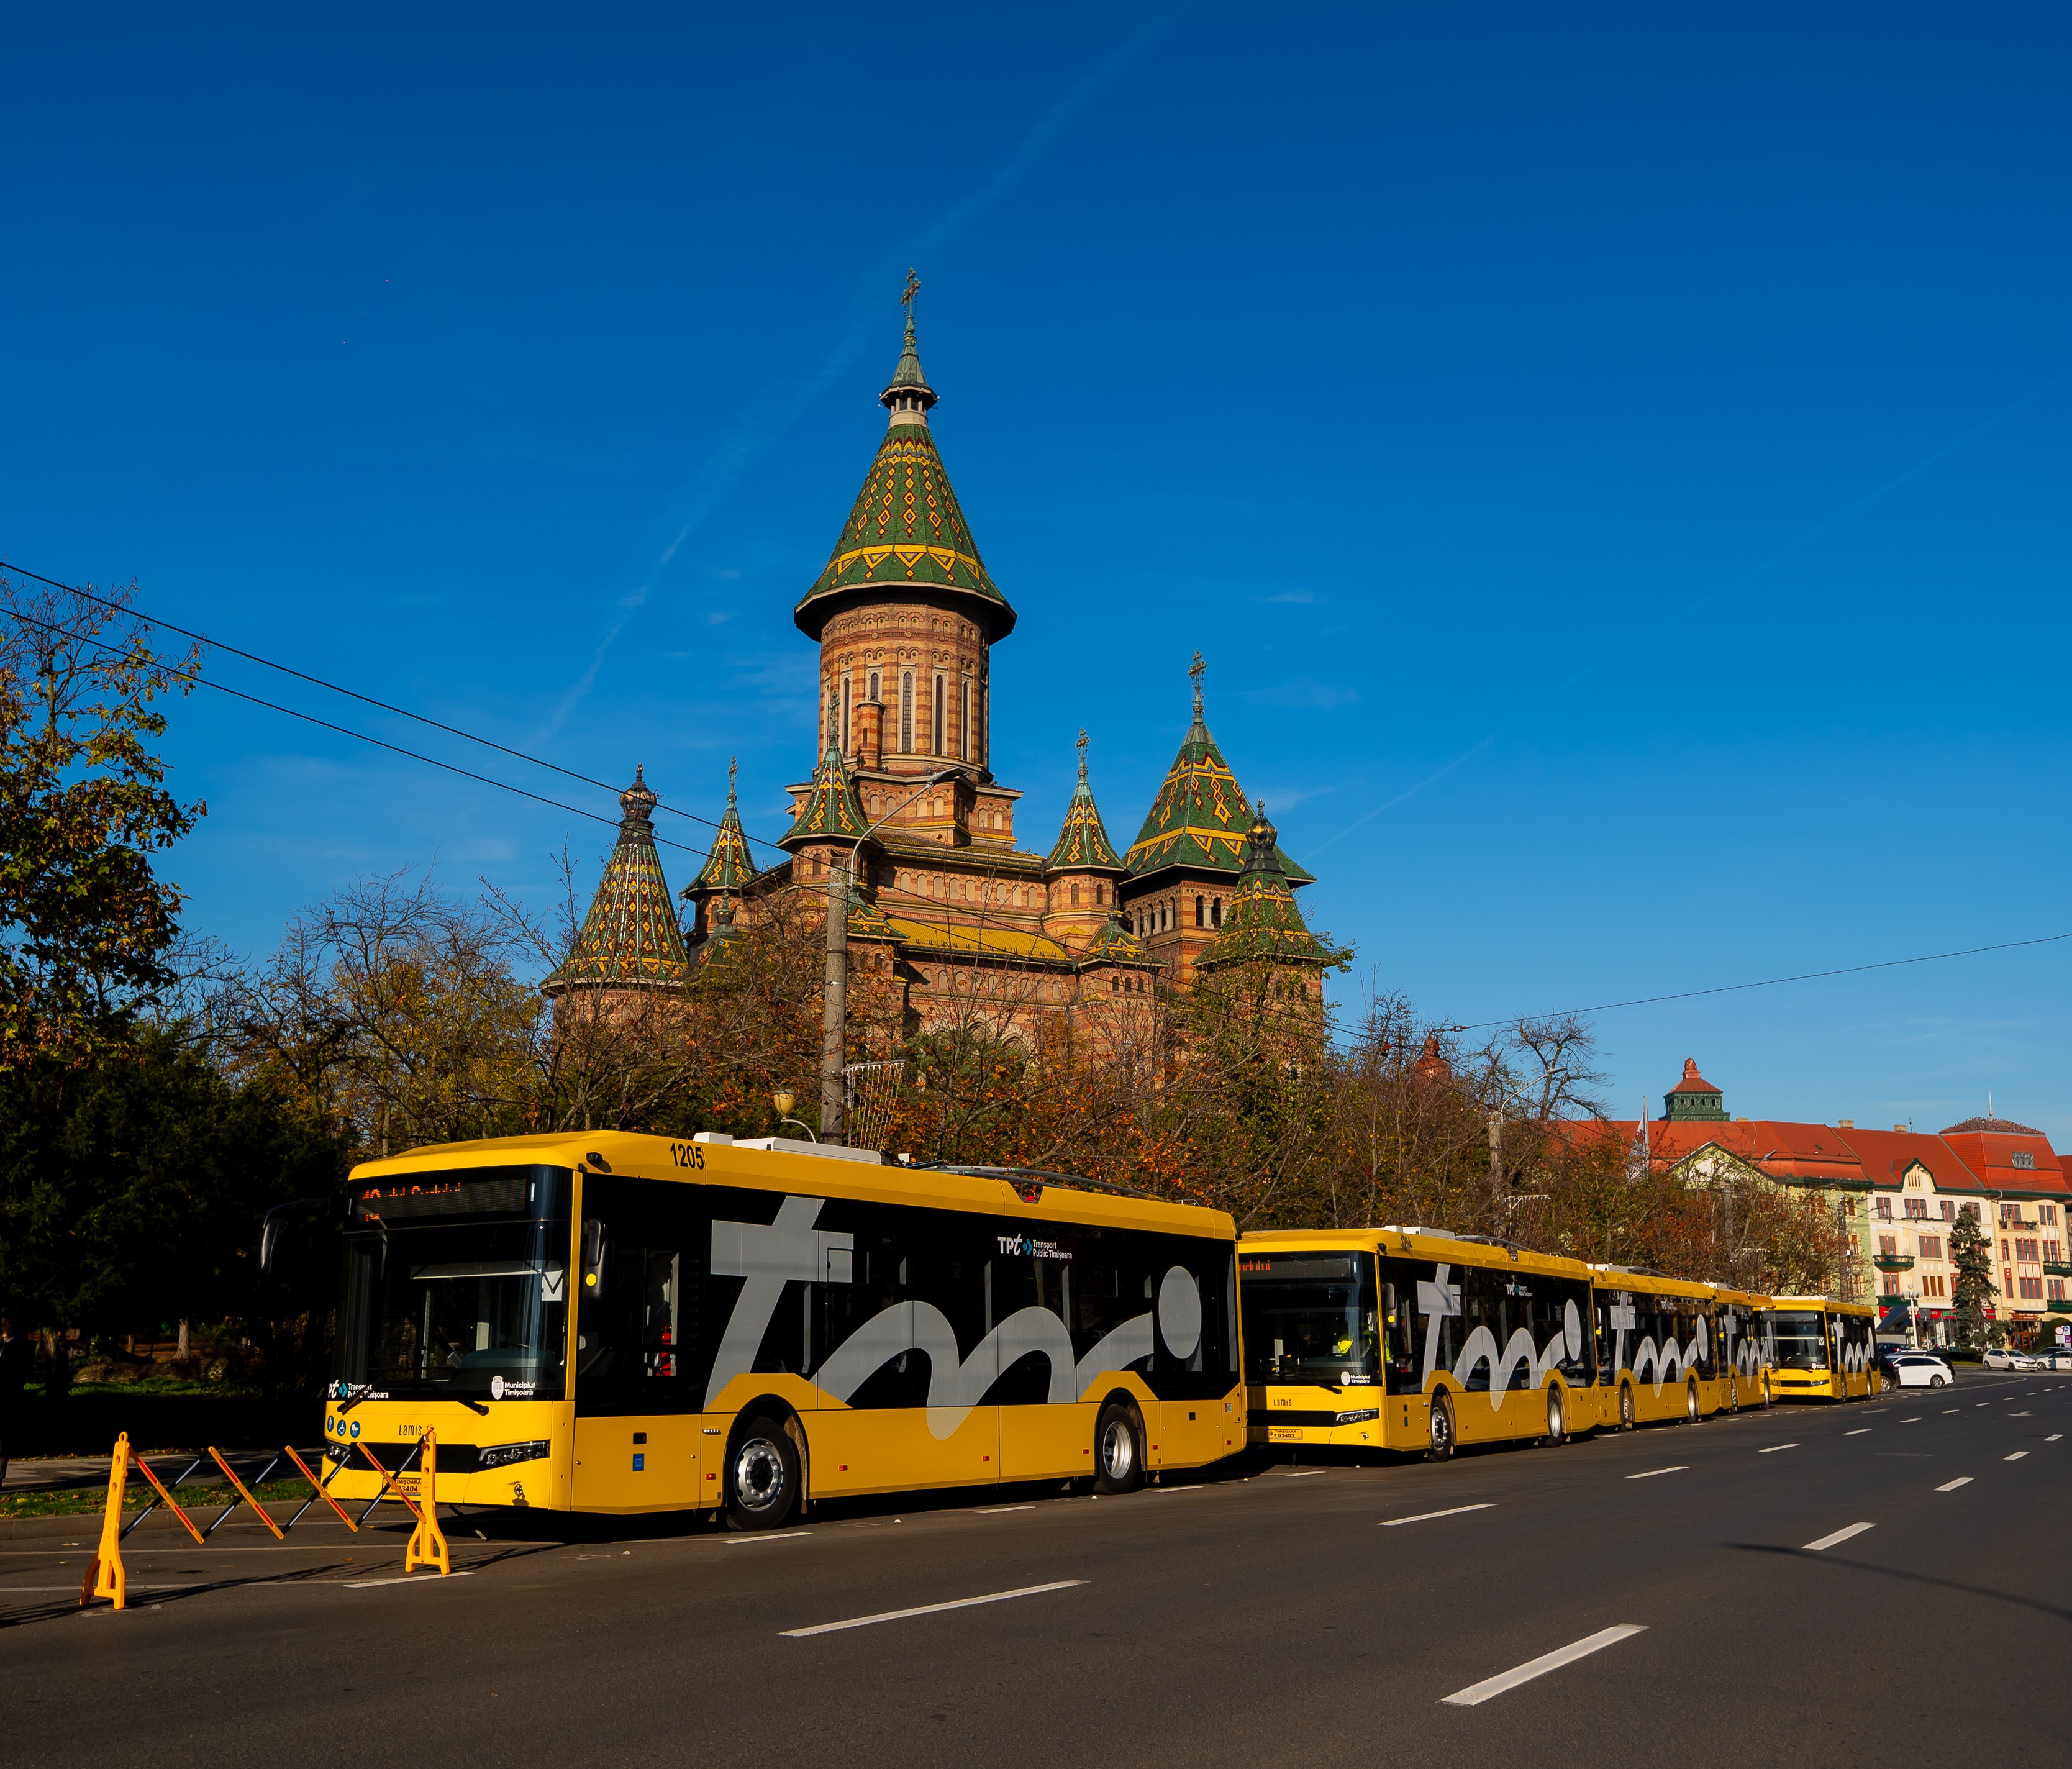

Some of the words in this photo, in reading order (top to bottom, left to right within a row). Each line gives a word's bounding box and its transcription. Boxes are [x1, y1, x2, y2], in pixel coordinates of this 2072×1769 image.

[670, 1142, 704, 1170] 1205
[1032, 1239, 1057, 1250] Transport
[1032, 1248, 1048, 1257] Public
[504, 1381, 535, 1390] Municipiul
